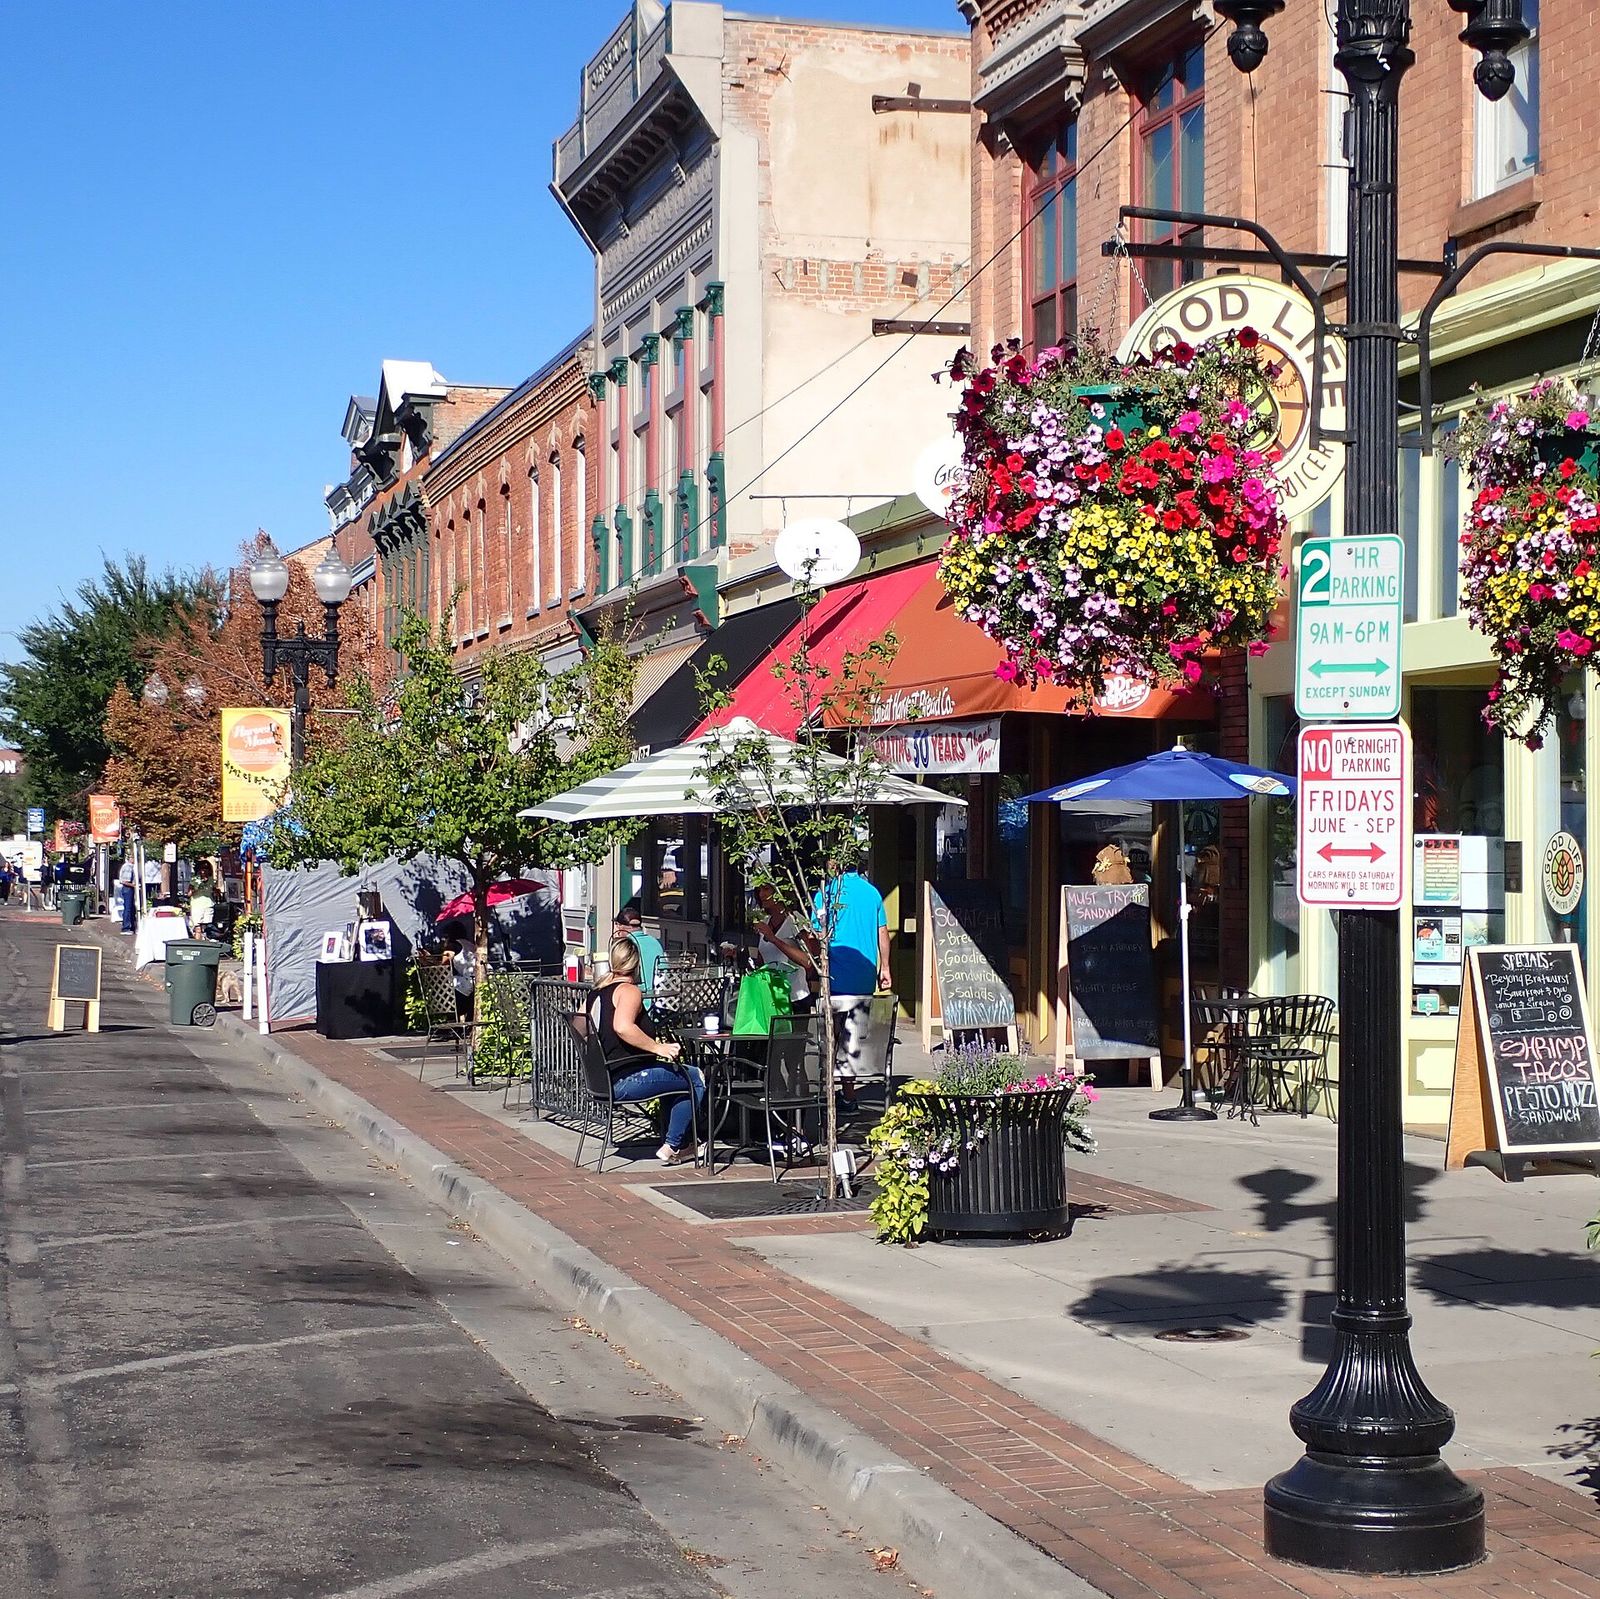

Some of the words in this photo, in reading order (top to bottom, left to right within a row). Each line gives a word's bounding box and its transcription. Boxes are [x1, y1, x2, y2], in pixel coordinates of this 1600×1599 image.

[1354, 547, 1379, 568] HR
[1302, 549, 1331, 602] 2
[1332, 575, 1397, 599] PARKING
[1305, 686, 1346, 699] EXCEPT
[1349, 685, 1391, 698] SUNDAY
[930, 732, 966, 762] YEARS
[1303, 739, 1332, 772] NO
[1335, 738, 1398, 755] OVERNIGHT
[1341, 758, 1391, 773] PARKING
[1309, 790, 1395, 812] FRIDAYS
[1308, 817, 1346, 833] JUNE
[1366, 817, 1395, 833] SEP
[1545, 835, 1564, 874] GOOD
[1567, 839, 1582, 874] LIFE
[1308, 871, 1327, 879] CARS
[1328, 871, 1356, 880] PARKED
[1358, 871, 1395, 880] SATURDAY
[1308, 881, 1339, 891] MORNING
[1340, 881, 1357, 891] WILL
[1359, 881, 1368, 890] BE
[1371, 881, 1395, 891] TOWED
[1067, 890, 1099, 906] MUST
[1105, 889, 1130, 906] TRY
[944, 948, 997, 966] Goodies
[955, 986, 996, 1002] Salads
[1499, 1035, 1587, 1061] SHRIMP
[1512, 1061, 1591, 1084] TACOS
[1504, 1084, 1561, 1117] PESTO
[1561, 1080, 1597, 1108] MOZZ
[1518, 1107, 1581, 1125] SANDWICH
